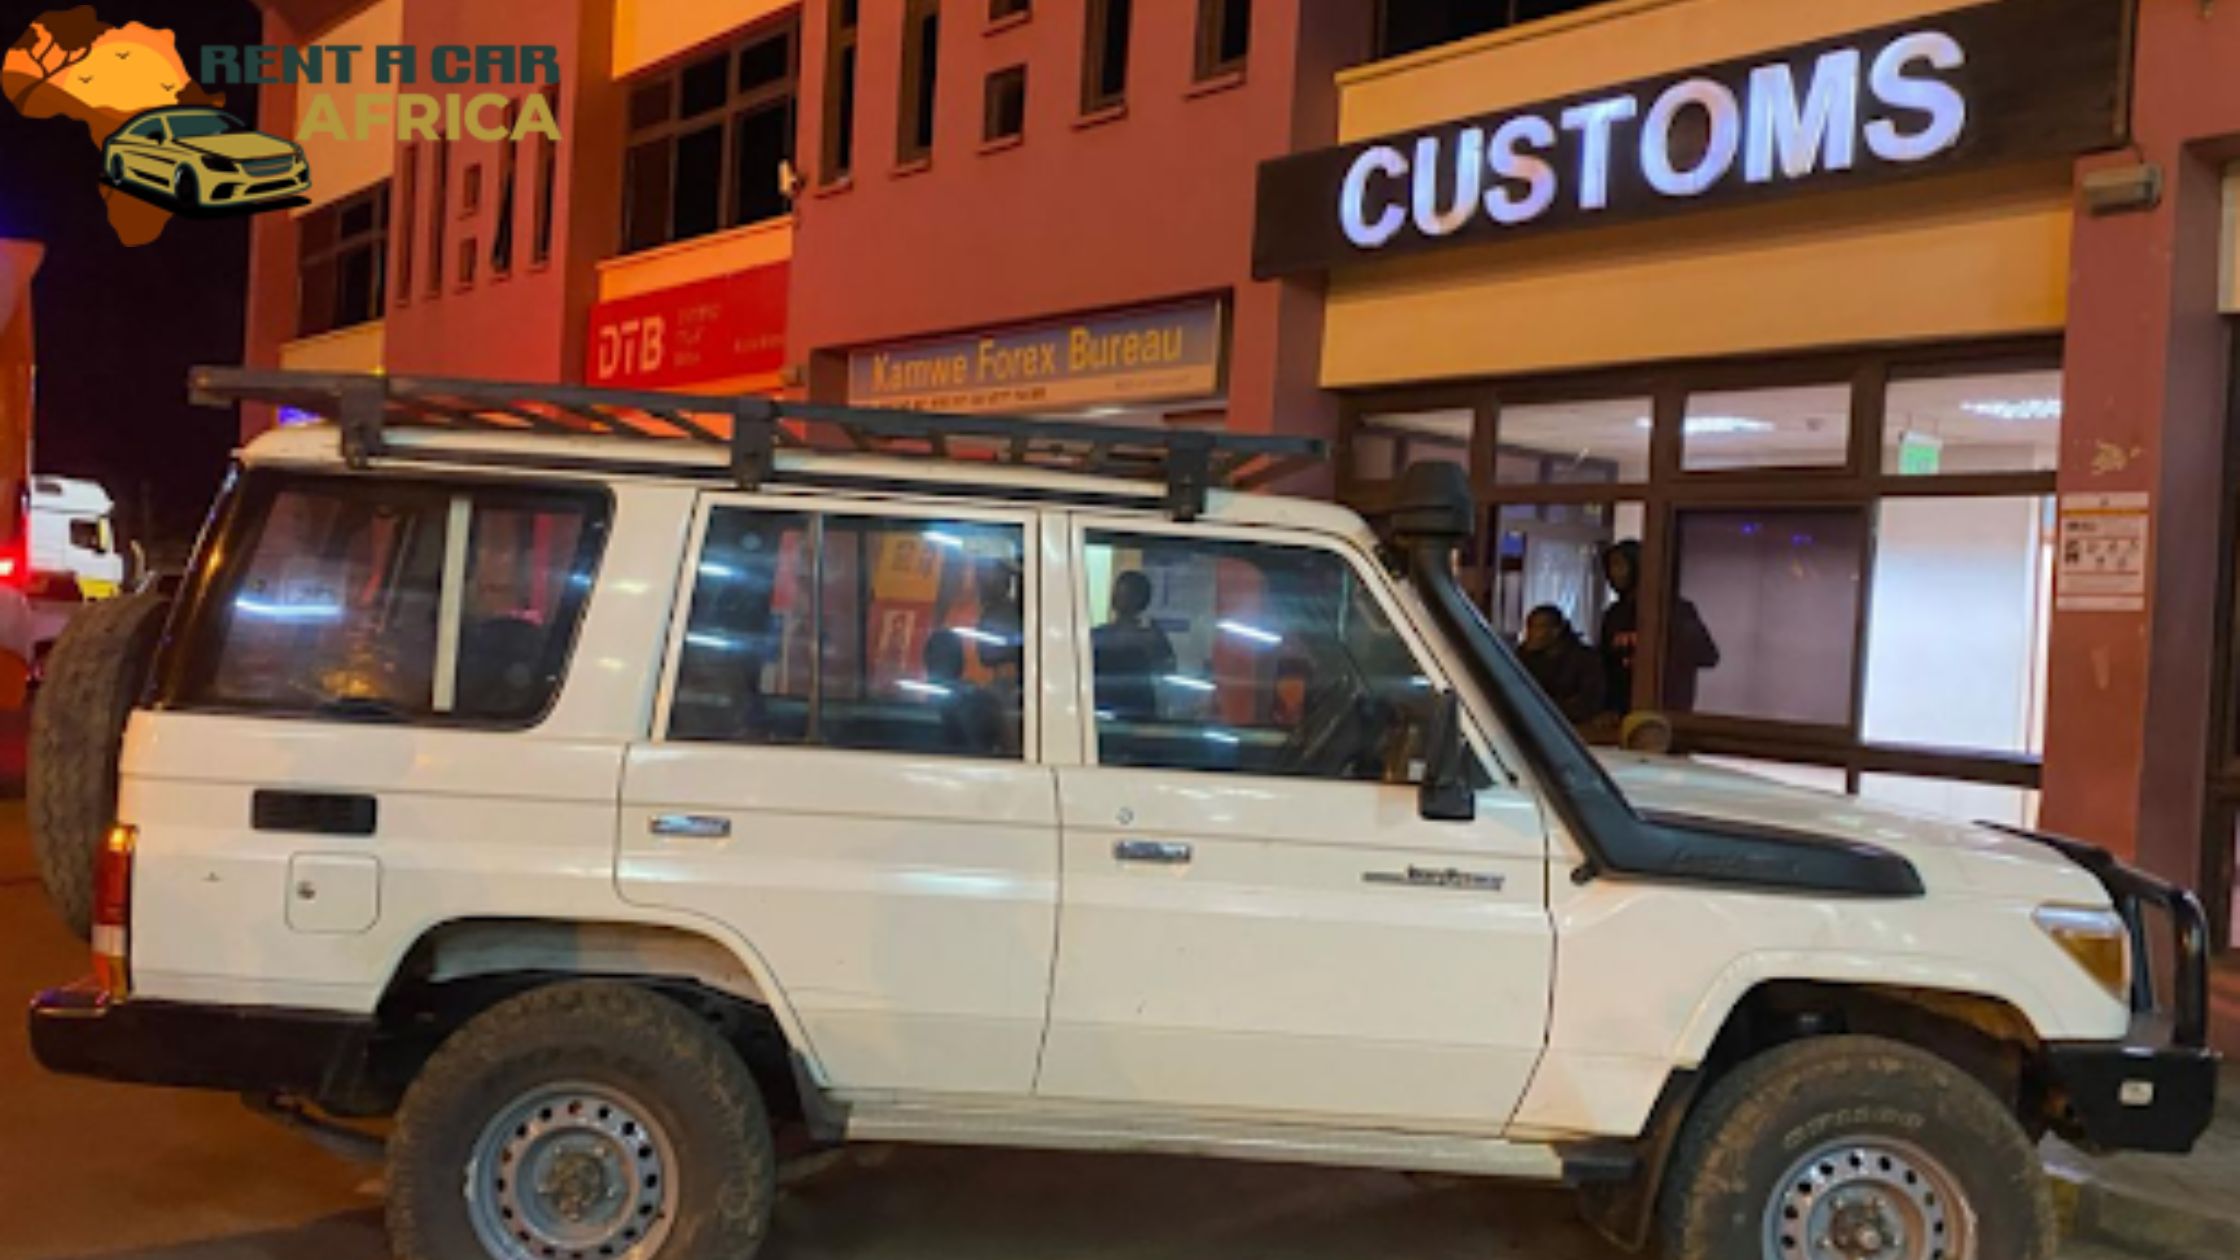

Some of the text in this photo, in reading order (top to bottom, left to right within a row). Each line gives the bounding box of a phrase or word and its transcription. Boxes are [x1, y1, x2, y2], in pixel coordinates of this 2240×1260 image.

[1338, 30, 1968, 249] CUSTOMS
[597, 314, 666, 380] DTB
[870, 325, 1185, 392] Kamwe Forex Bureau
